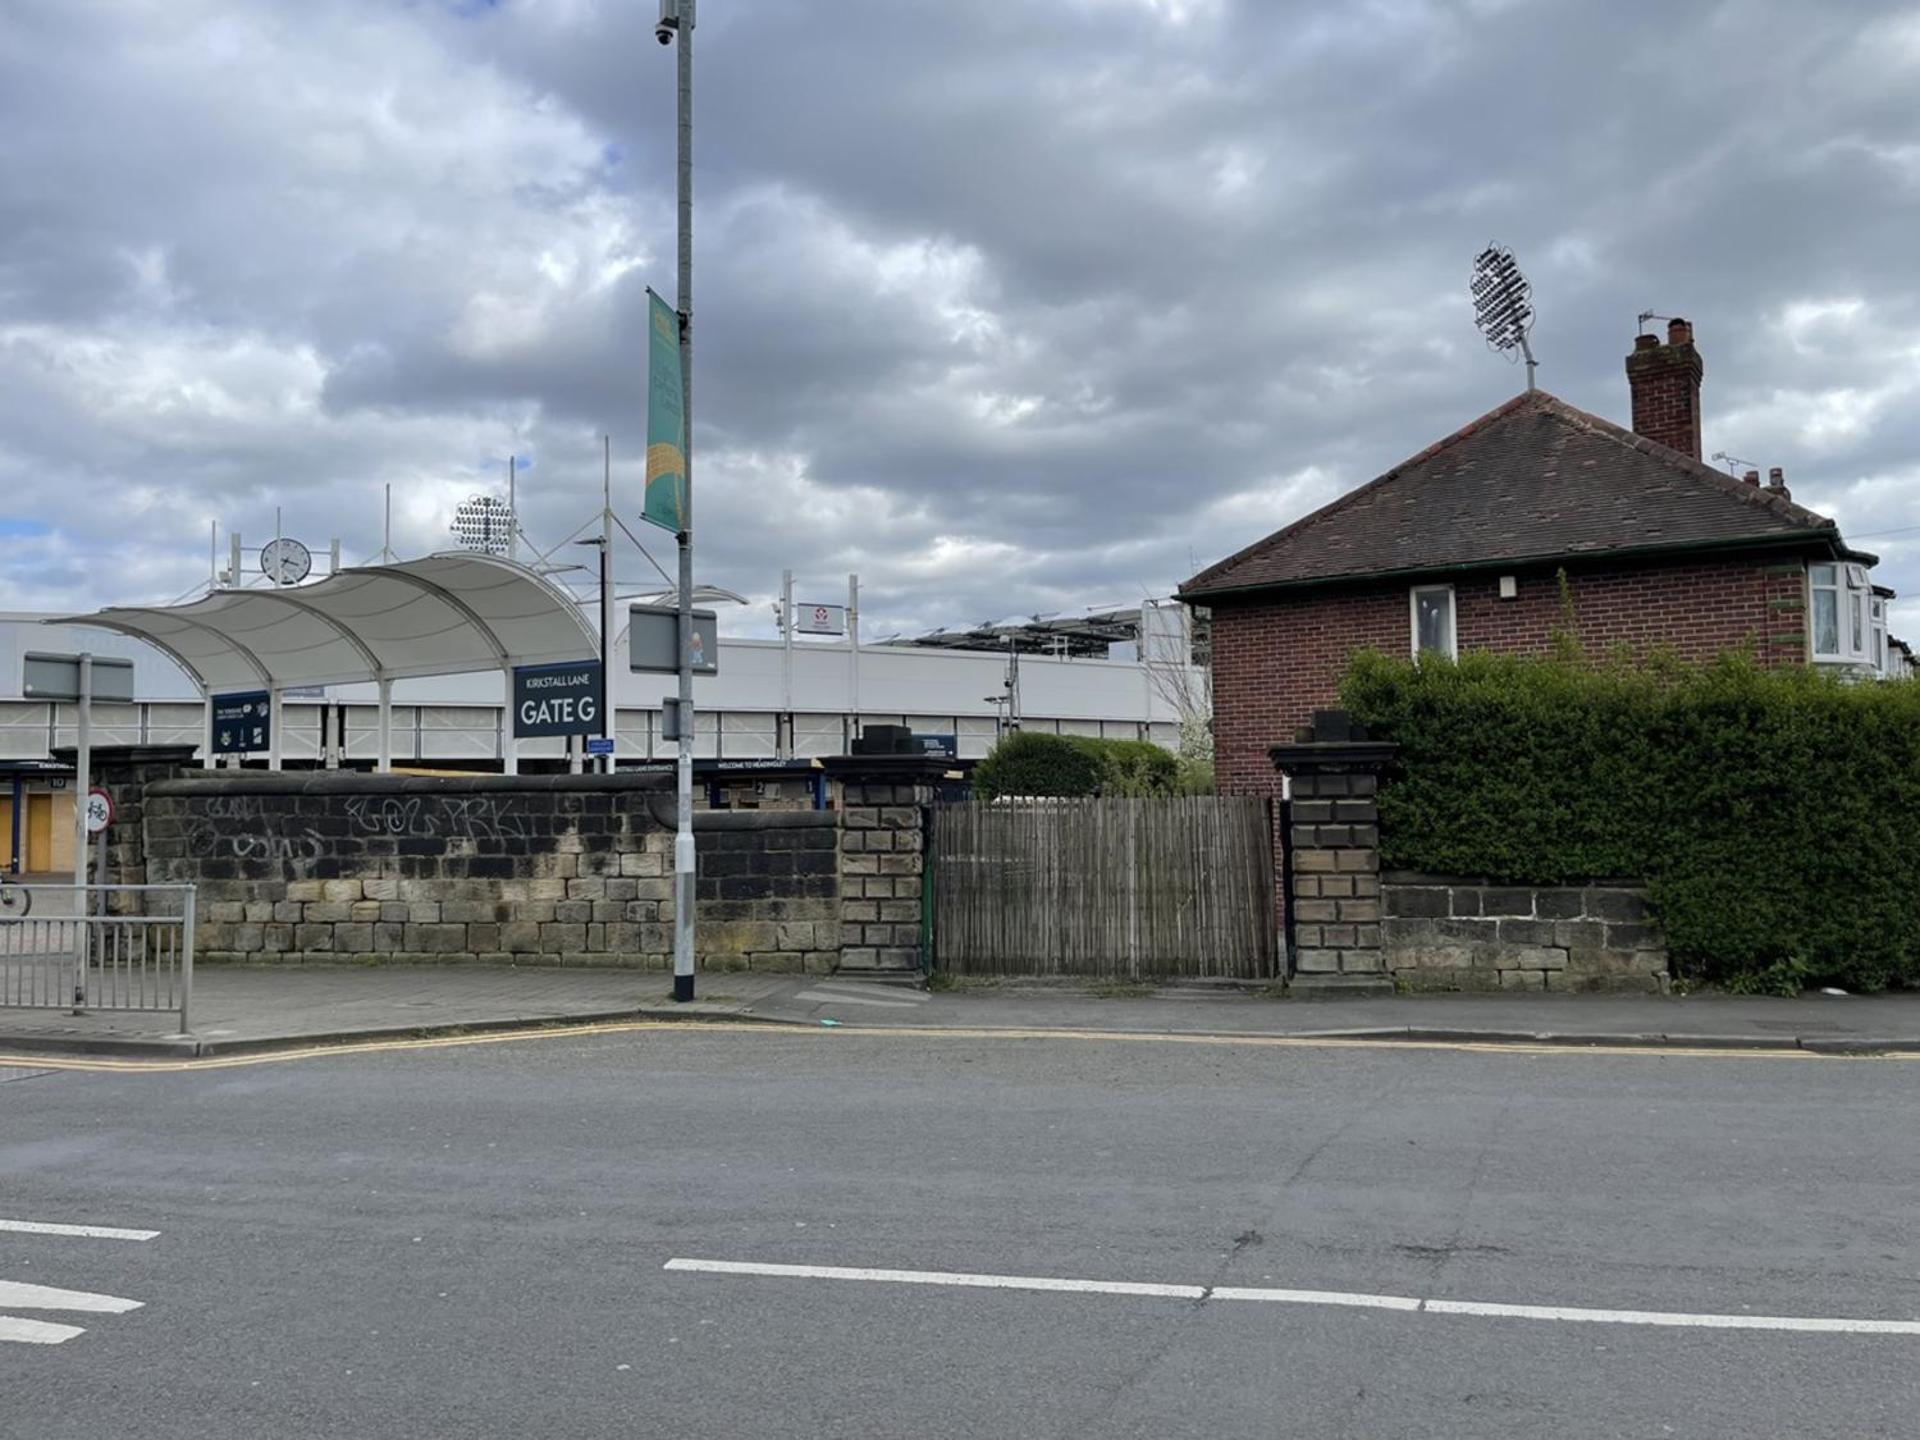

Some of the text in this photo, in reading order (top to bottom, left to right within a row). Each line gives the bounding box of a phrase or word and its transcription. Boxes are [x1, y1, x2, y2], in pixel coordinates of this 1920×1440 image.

[526, 673, 590, 689] KIRKSTALL LANE
[521, 696, 596, 725] GATE G
[53, 778, 65, 787] 10
[757, 782, 764, 793] 2
